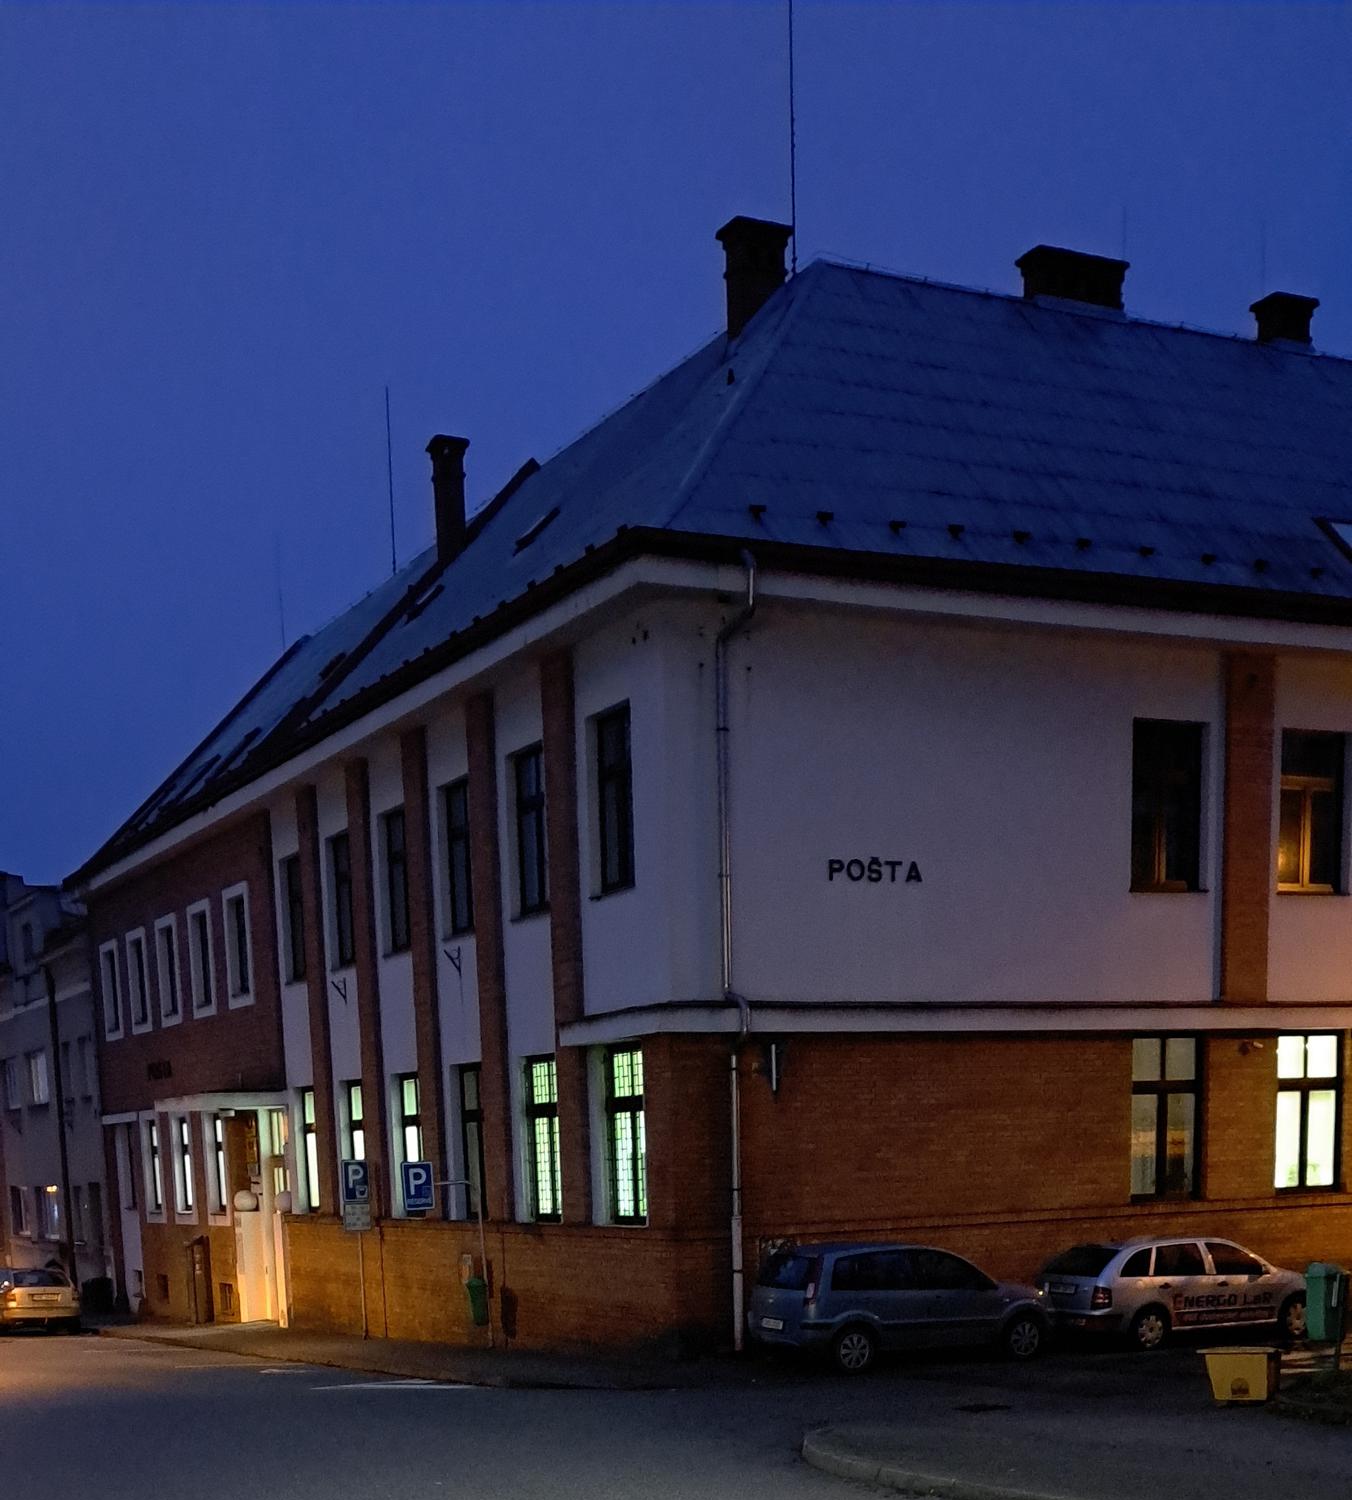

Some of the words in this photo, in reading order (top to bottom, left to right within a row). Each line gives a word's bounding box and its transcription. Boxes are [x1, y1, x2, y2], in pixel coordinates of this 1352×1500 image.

[828, 856, 923, 882] POŠTA
[348, 1165, 364, 1188] P
[409, 1168, 427, 1195] P
